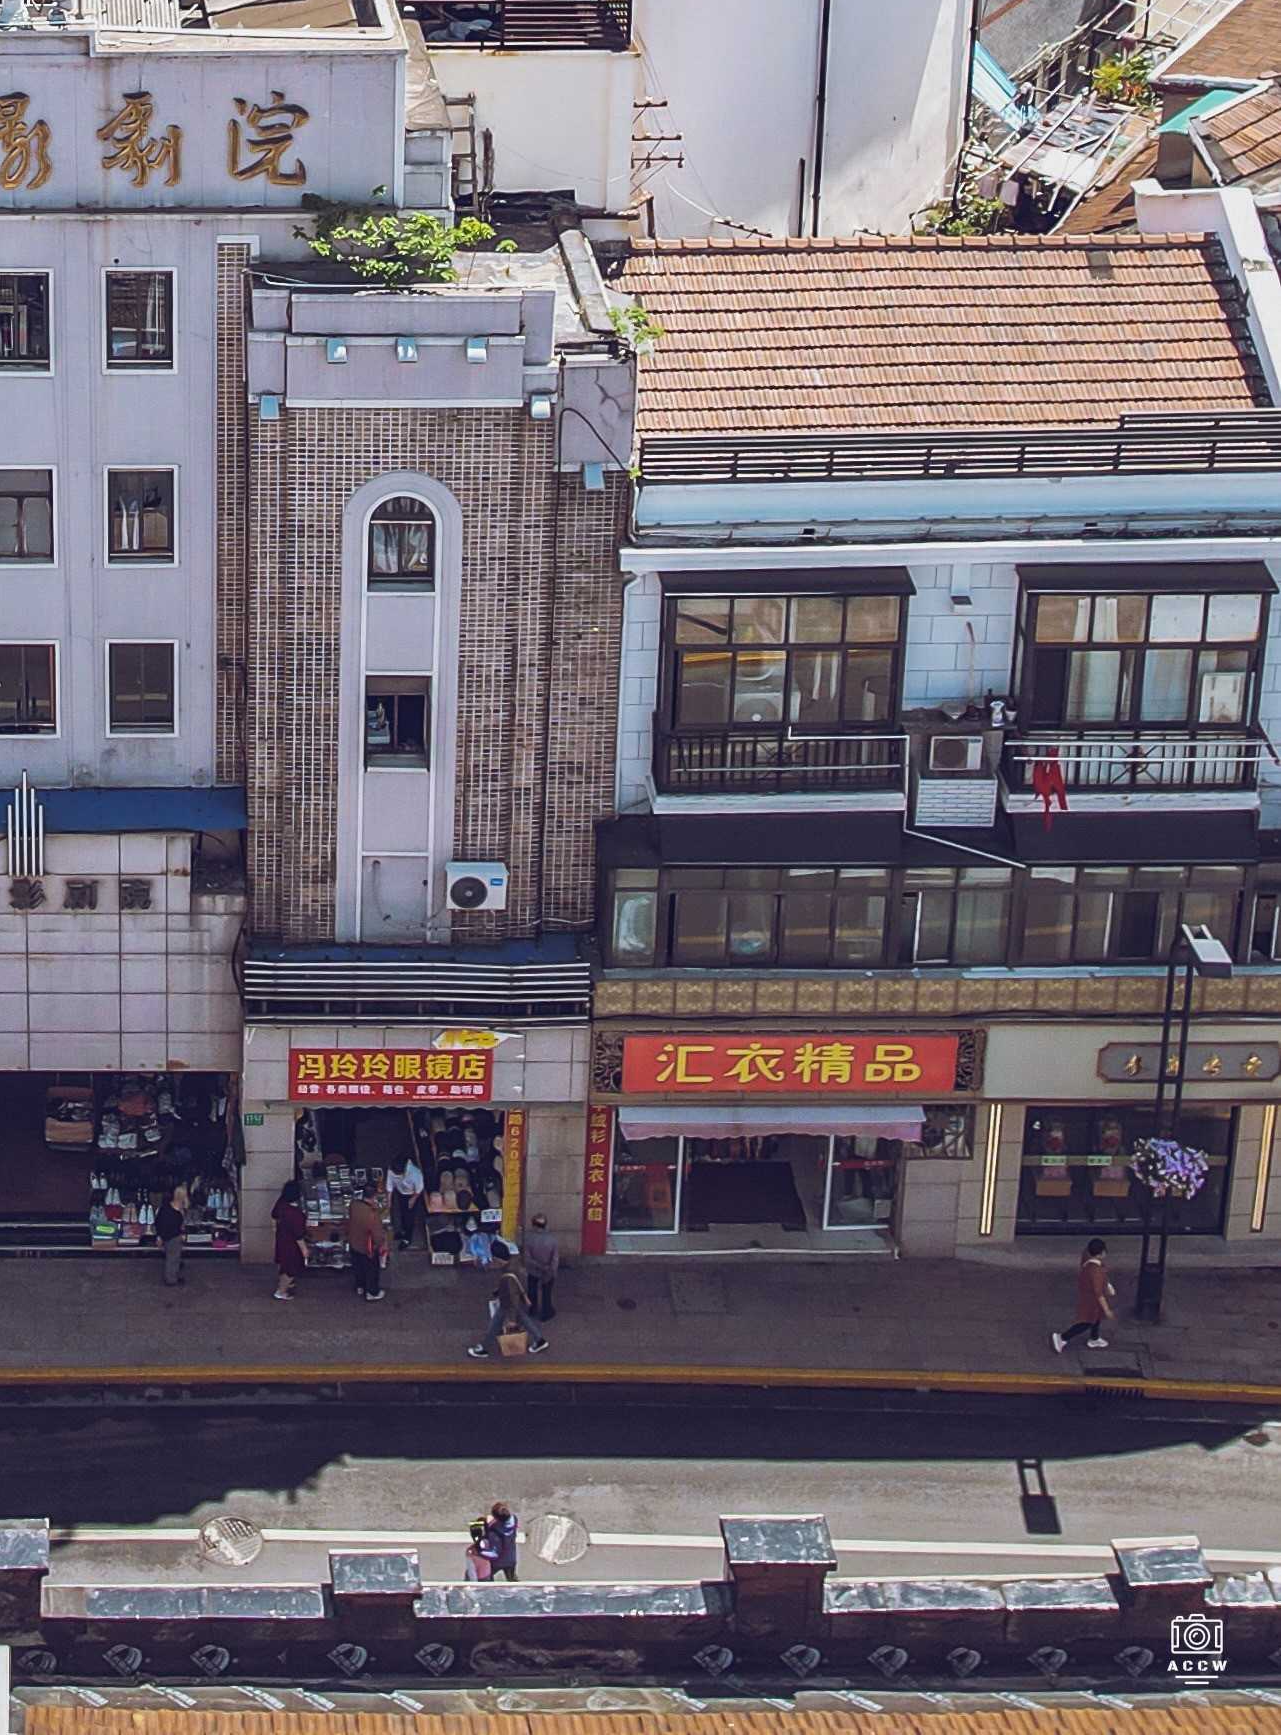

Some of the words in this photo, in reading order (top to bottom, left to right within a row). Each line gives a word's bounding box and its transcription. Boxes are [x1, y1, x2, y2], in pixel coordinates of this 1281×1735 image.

[297, 1053, 486, 1080] 冯玲玲眼镜店
[656, 1042, 922, 1085] 汇衣精品
